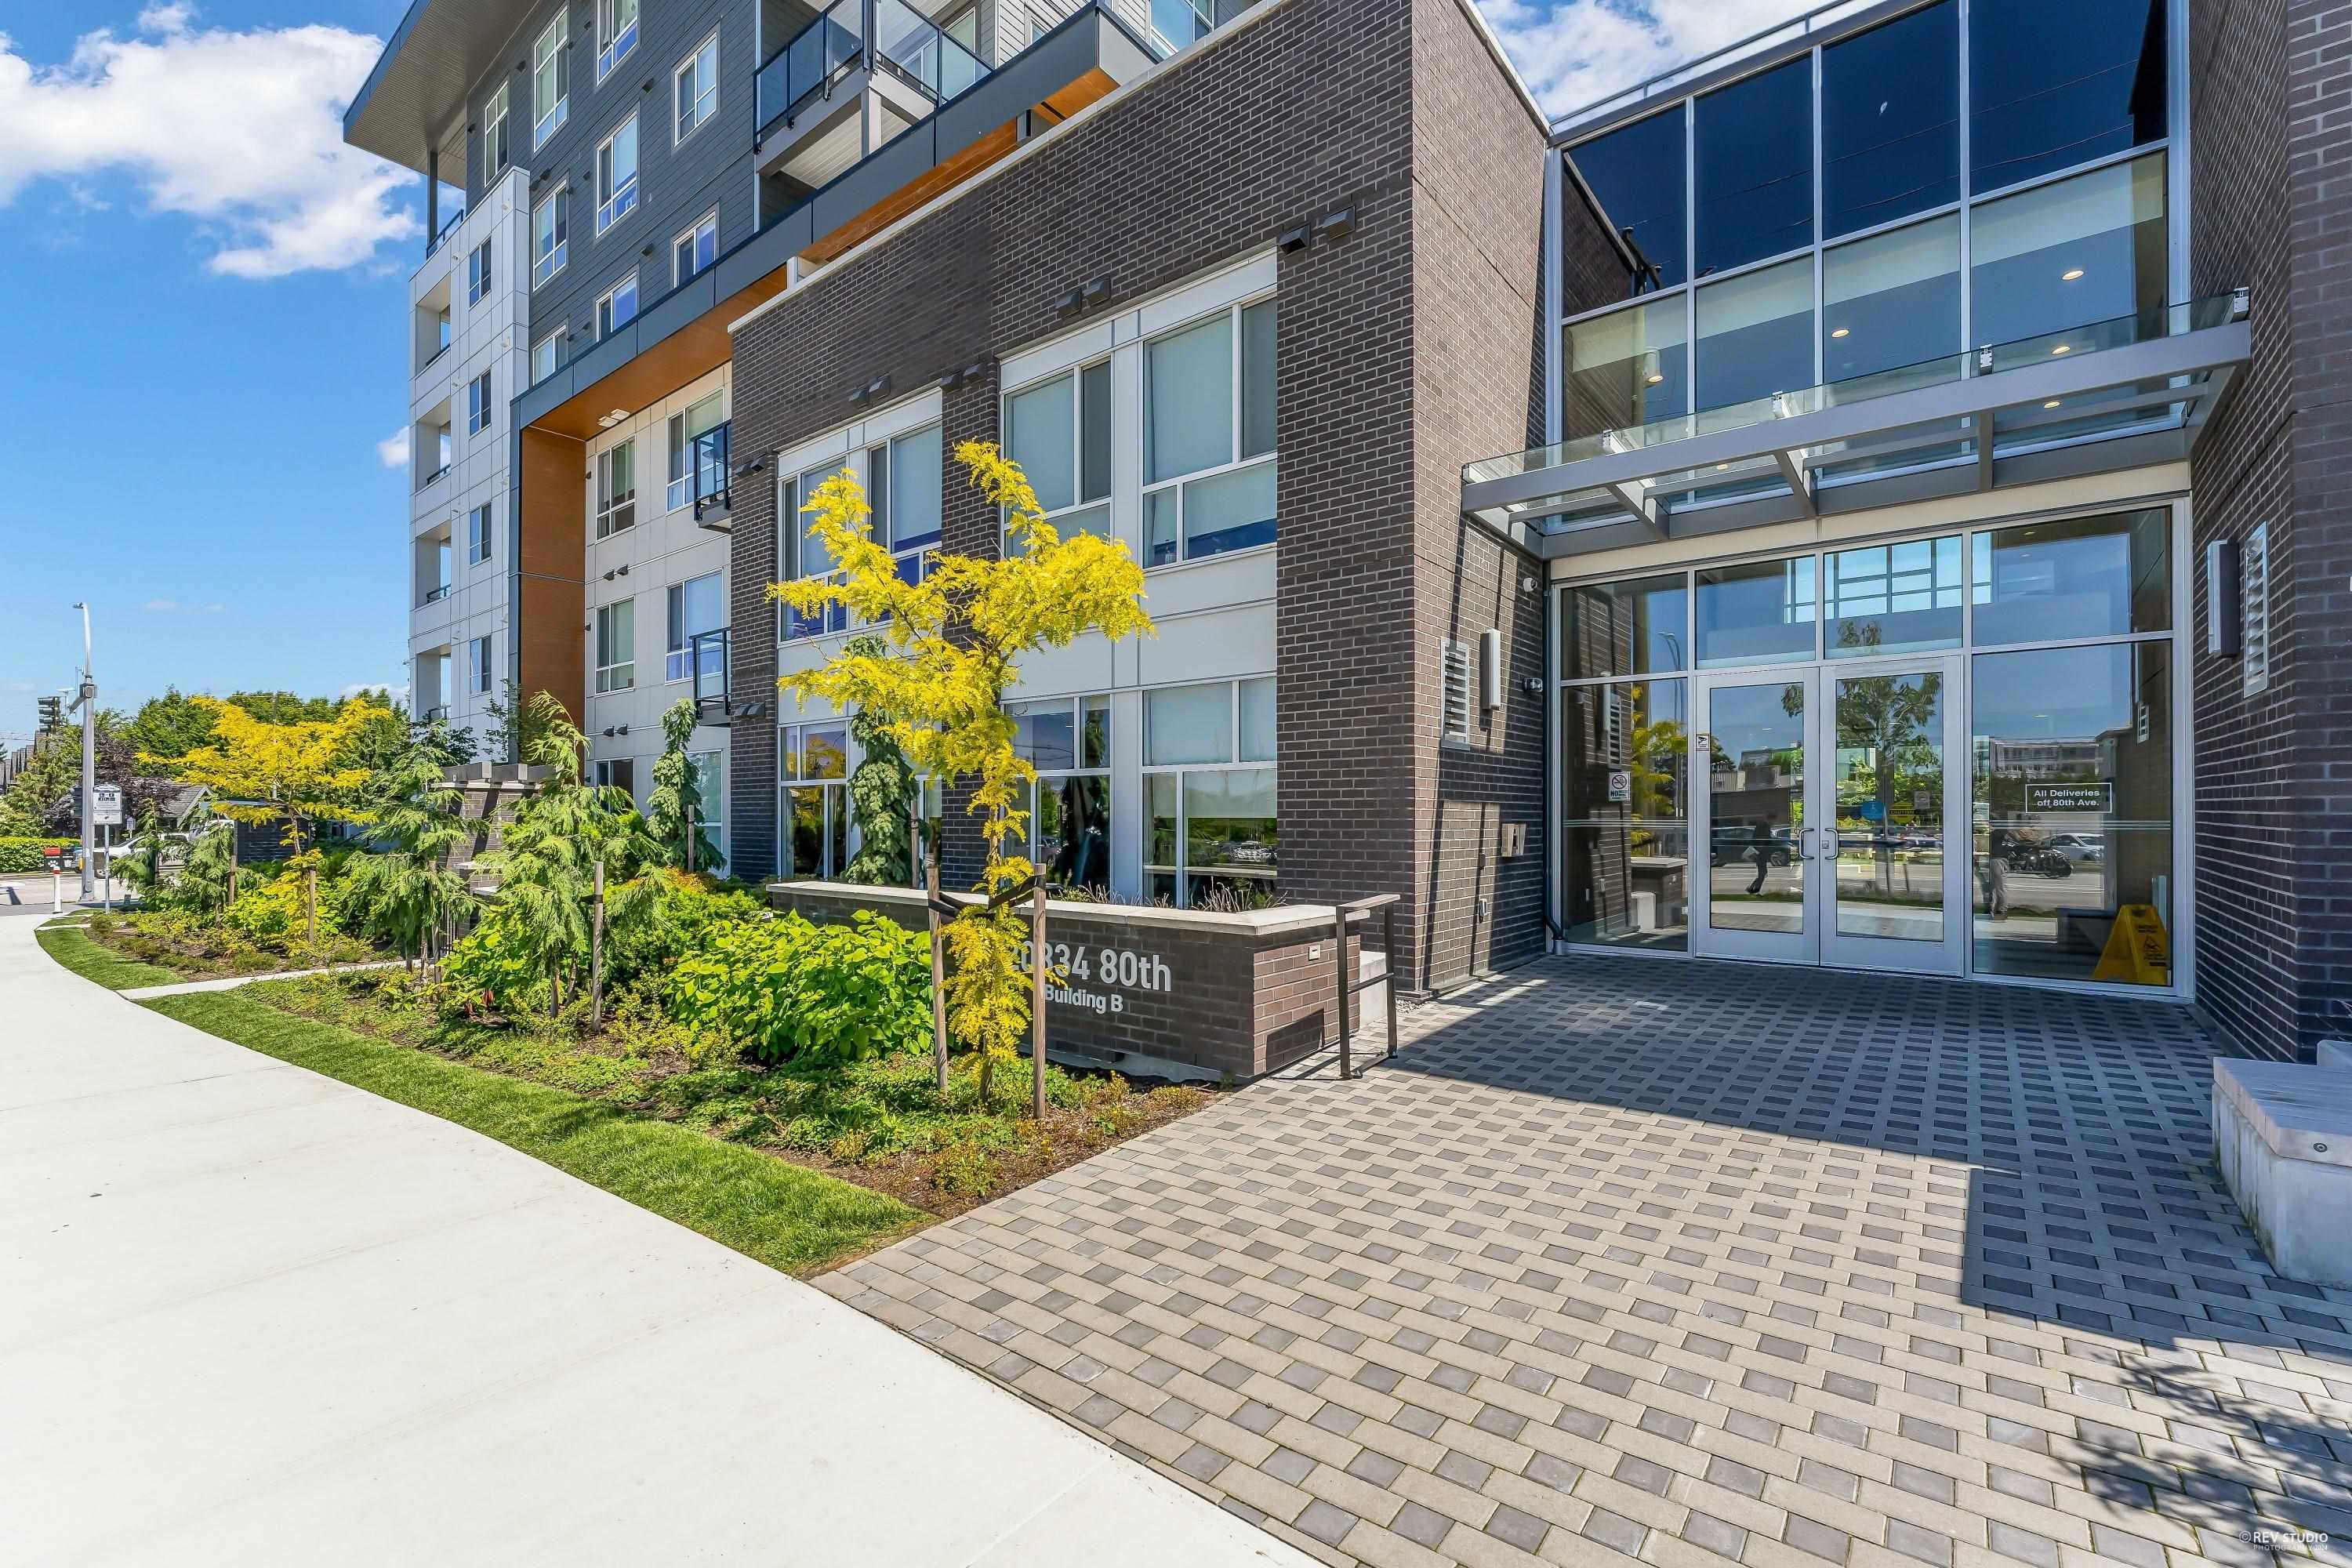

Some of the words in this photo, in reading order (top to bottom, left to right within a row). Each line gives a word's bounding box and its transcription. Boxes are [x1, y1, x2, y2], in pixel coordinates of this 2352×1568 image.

[1099, 949, 1171, 992] 80th
[1045, 984, 1107, 1014] Building
[1111, 993, 1123, 1012] B
